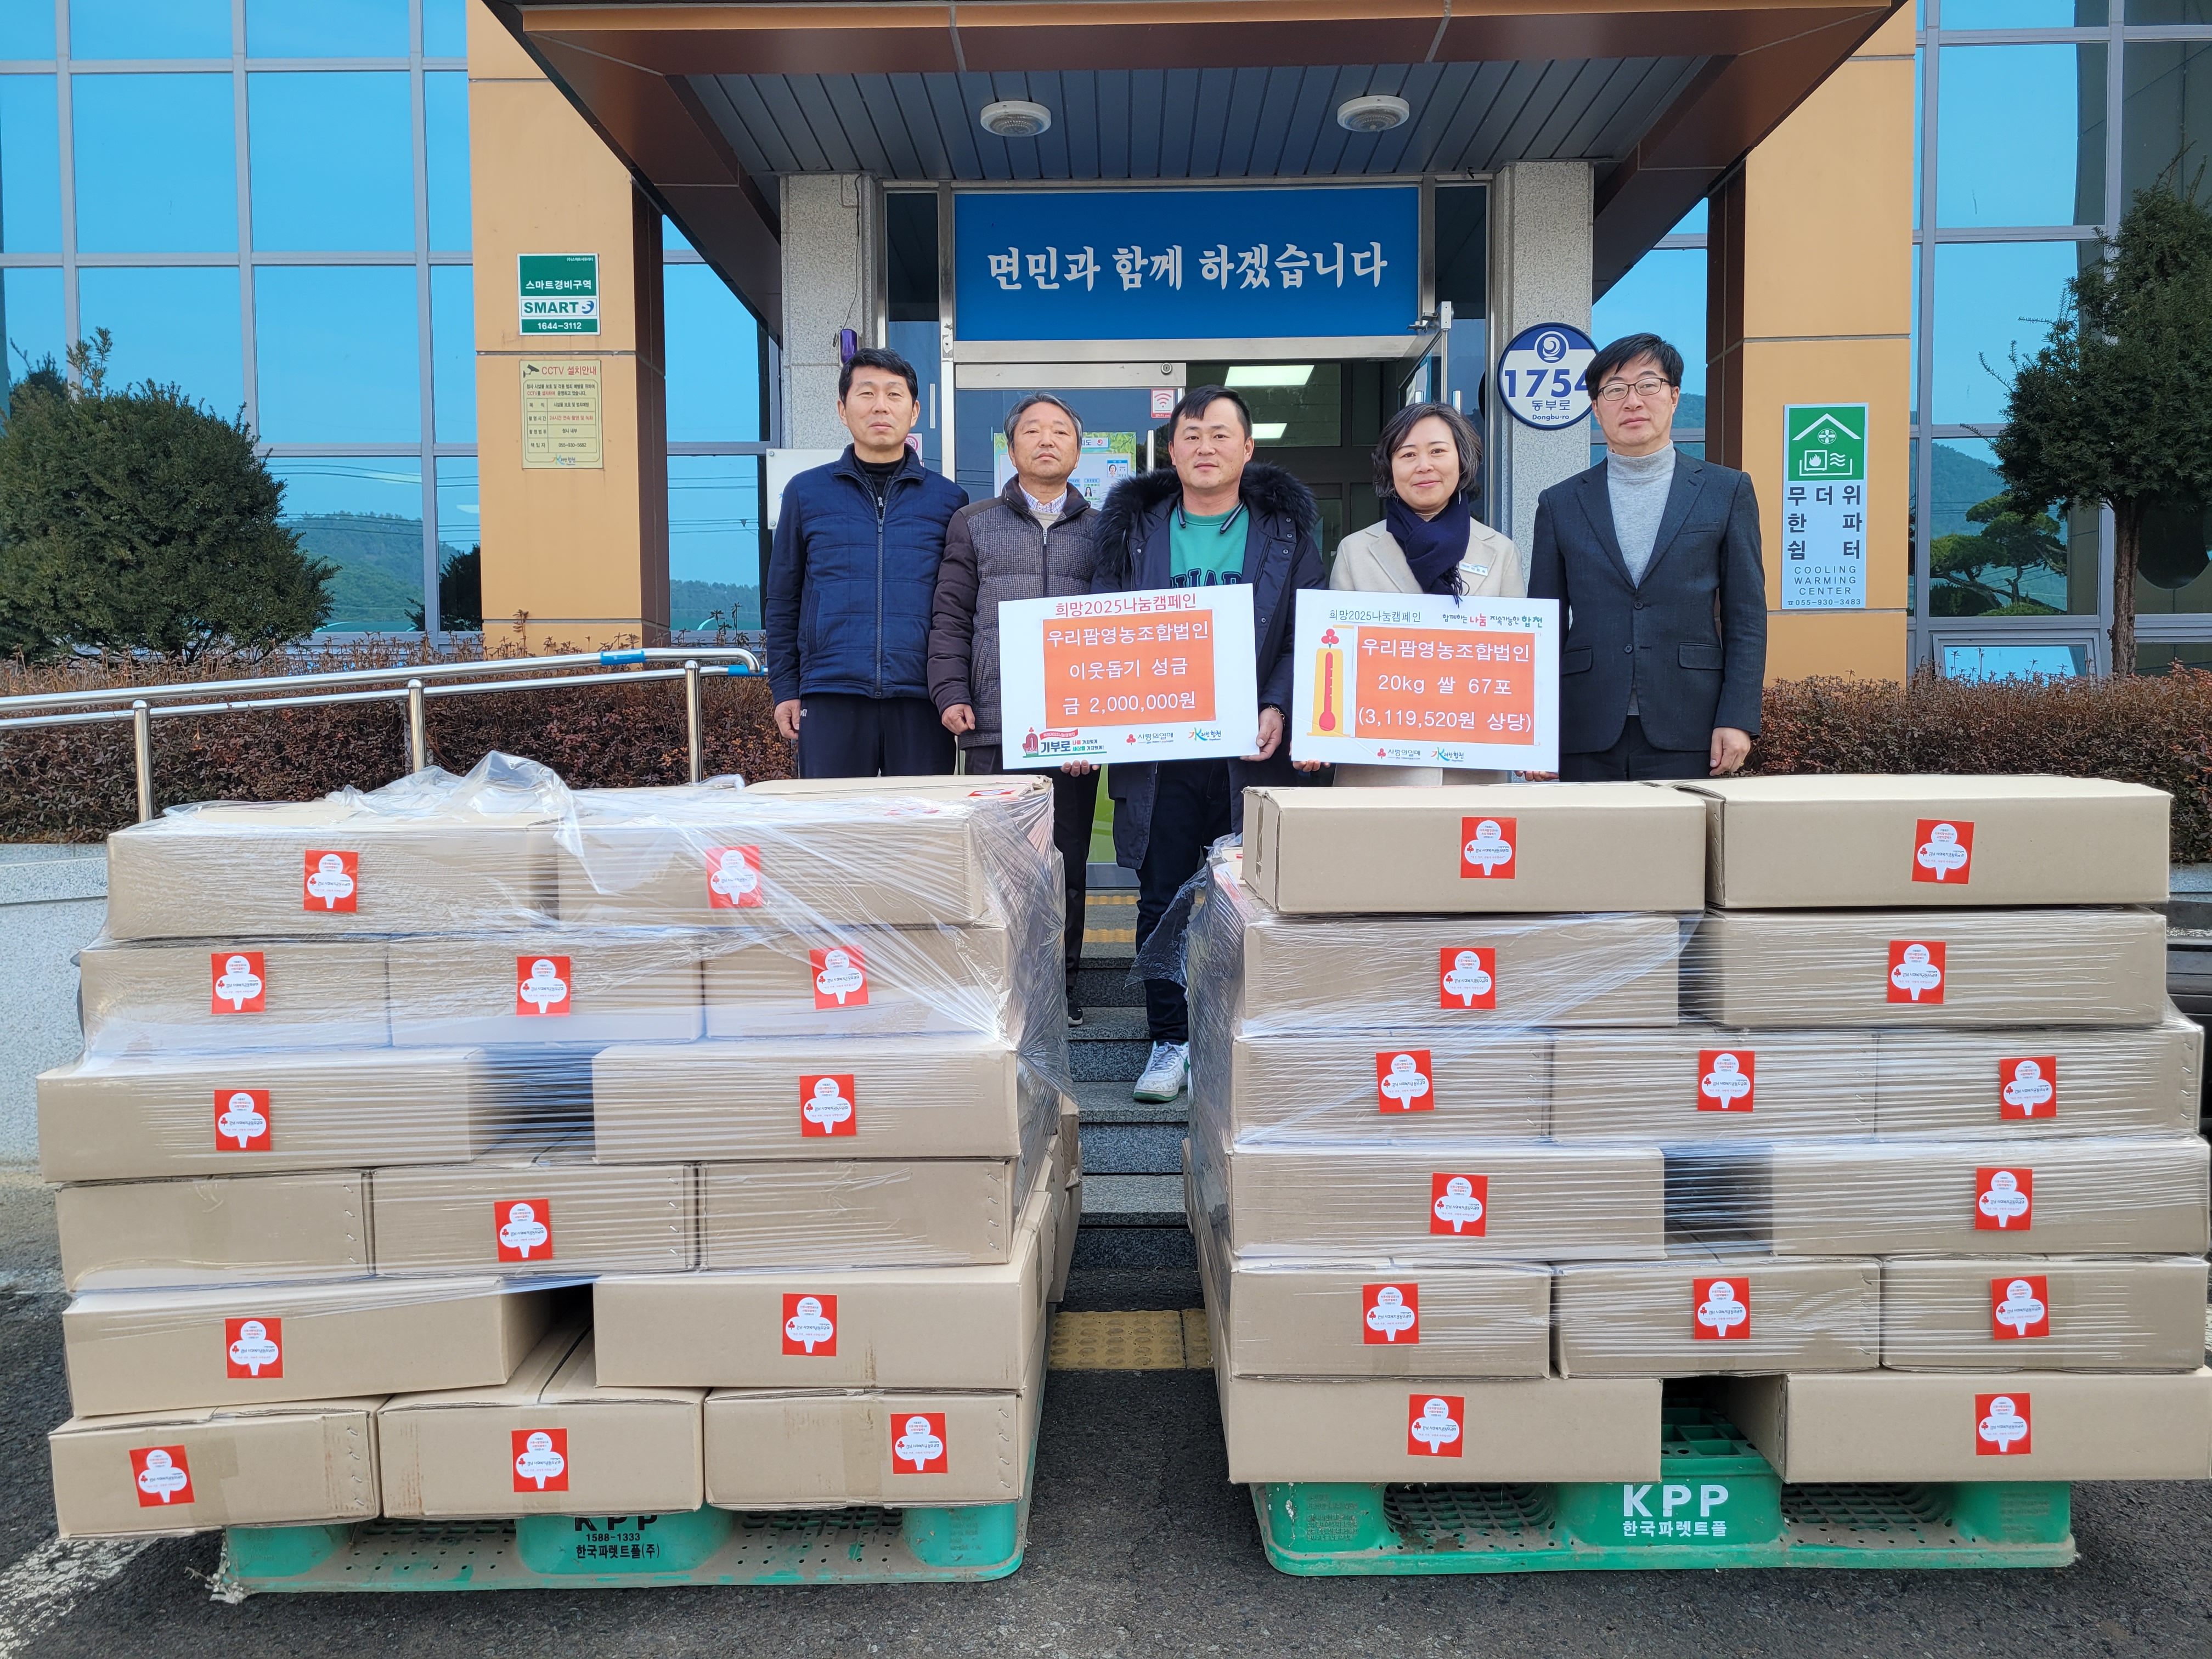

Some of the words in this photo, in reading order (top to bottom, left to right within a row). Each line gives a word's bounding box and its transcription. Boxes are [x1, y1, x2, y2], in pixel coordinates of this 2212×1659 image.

[987, 246, 1102, 292] 면민과
[1111, 245, 1184, 291] 함께
[1198, 241, 1389, 291] 하겠습니다
[525, 279, 591, 290] 스마트경비구역
[523, 302, 579, 314] SMART
[538, 321, 582, 330] 1644-3112
[541, 366, 565, 375] CCTV
[567, 365, 597, 376] 설치안내
[1532, 400, 1570, 411] 동부로
[1794, 566, 1857, 574] COOLING
[1794, 576, 1857, 585] WARMING
[1799, 587, 1852, 595] CENTER
[1055, 593, 1197, 617] 희망2025나눔캠페인
[1329, 608, 1421, 623] 희망2025나눔캠페인
[1442, 613, 1468, 624] 함께하는
[1469, 613, 1487, 627] 나눔
[1489, 616, 1520, 627] 지속가능한
[1521, 615, 1543, 628] 합천
[1046, 620, 1209, 648] 우리팜영농조합법인
[1361, 638, 1530, 663] 우리팜영농조합법인
[1069, 658, 1141, 680] 이웃돕기
[1152, 657, 1188, 676] 성금
[1378, 674, 1425, 695] 20kg
[1437, 675, 1456, 695] 쌀
[1468, 678, 1513, 695] 67포
[1062, 697, 1080, 715] 금
[1089, 691, 1196, 715] 2,000,000원
[1358, 707, 1476, 730] (3,119,520원
[1487, 713, 1532, 733] 상당)
[1137, 732, 1173, 741] 사랑의열매
[1040, 741, 1071, 753] 기부로
[1387, 749, 1421, 757] 사랑의열매
[1623, 1484, 1729, 1517] KPP
[1622, 1520, 1727, 1537] 한국파렛트풀
[586, 1532, 641, 1542] 1588-1333
[576, 1543, 660, 1559] 한국파렛트풀(주)
